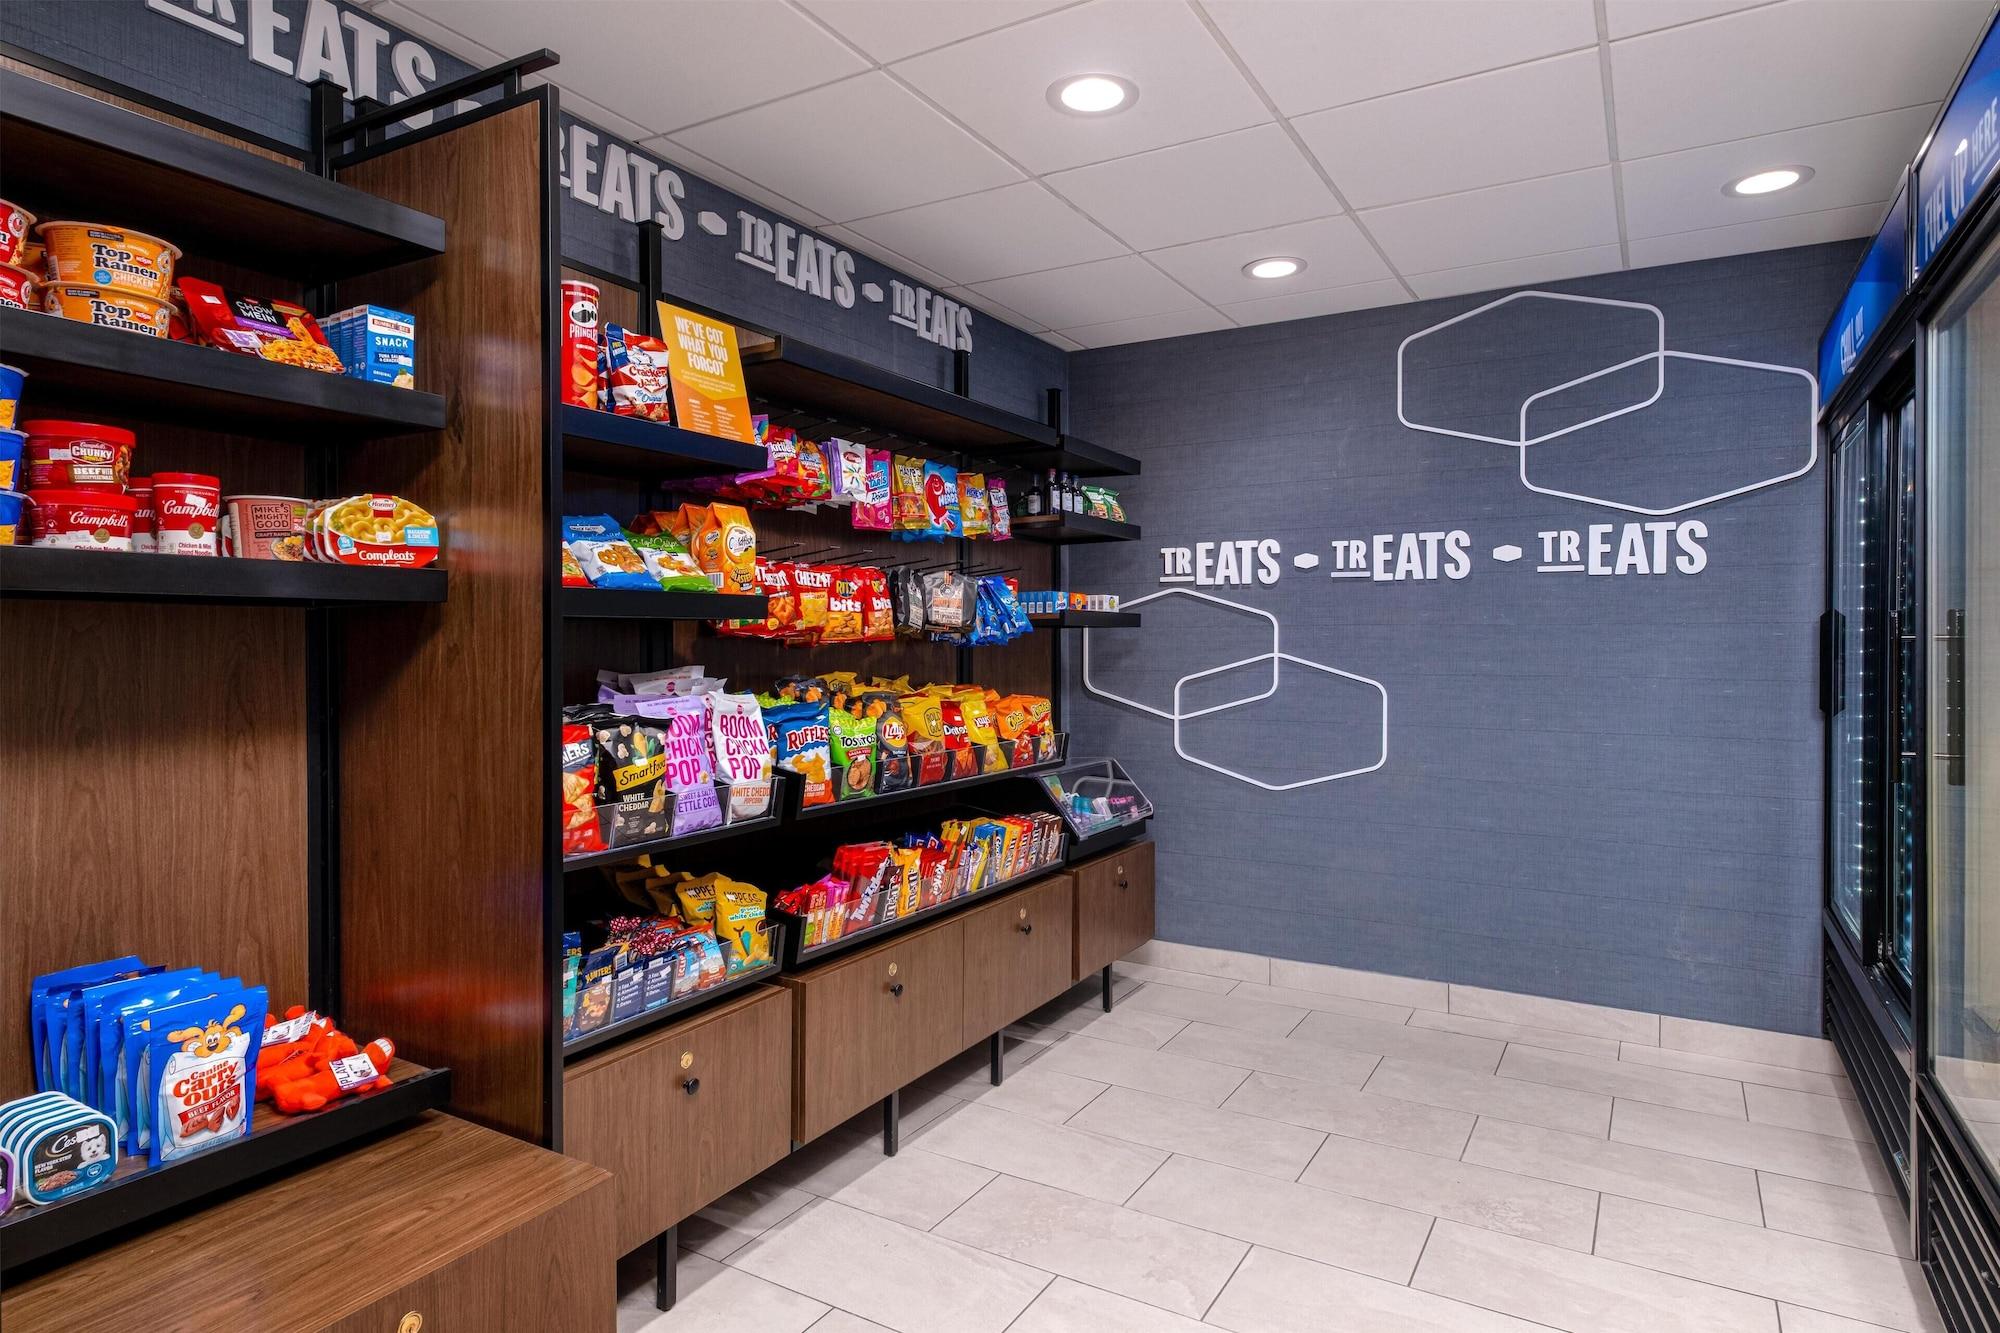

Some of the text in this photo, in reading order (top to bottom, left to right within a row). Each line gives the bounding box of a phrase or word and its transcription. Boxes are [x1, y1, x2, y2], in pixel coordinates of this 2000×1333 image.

[146, 0, 437, 130] EATS
[559, 124, 685, 241] EATS
[1925, 96, 1998, 263] FUEL UP HERE
[91, 242, 132, 263] Top
[735, 210, 855, 309] TREATS
[94, 256, 159, 280] Ramen
[113, 272, 154, 288] CHICKEN
[91, 300, 132, 319] Top
[235, 300, 273, 316] CHOW
[240, 308, 278, 324] MEIN
[889, 280, 972, 353] TREATS
[93, 313, 158, 337] Ramen
[674, 315, 724, 345] WE'VE GOT
[375, 336, 408, 348] SNACK
[677, 333, 728, 362] WHAT YOU
[687, 352, 725, 377] FORGOT
[72, 445, 112, 460] CHUNKY
[74, 467, 101, 475] BEEF
[254, 505, 289, 514] MIKE'S
[255, 513, 289, 521] MIGHTY
[256, 520, 289, 528] GOOD
[359, 549, 415, 563] Compleats
[1331, 530, 1471, 581] TREATS
[1537, 520, 1708, 576] TREATS
[1160, 538, 1281, 585] TREATS
[830, 596, 862, 612] bits
[668, 714, 700, 739] OOM
[720, 714, 764, 739] BOOM
[726, 737, 770, 757] CHICKA
[787, 725, 829, 751] RUFFLES
[841, 733, 876, 748] TOSTITOS
[563, 742, 590, 764] NERS
[665, 738, 704, 761] CHICK
[620, 759, 666, 786] Smartfood
[665, 758, 701, 789] POP
[727, 755, 761, 780] POP
[622, 792, 645, 803] WHITE
[731, 786, 770, 798] WHITE CHEDD
[618, 801, 649, 812] CHEDDAR
[678, 797, 719, 813] ETTLE COR
[729, 910, 766, 921] white chedd
[173, 1061, 239, 1098] Carry
[190, 1060, 229, 1080] Canine
[187, 1089, 235, 1119] BEEF FLAVOR
[51, 1134, 78, 1154] Ces
